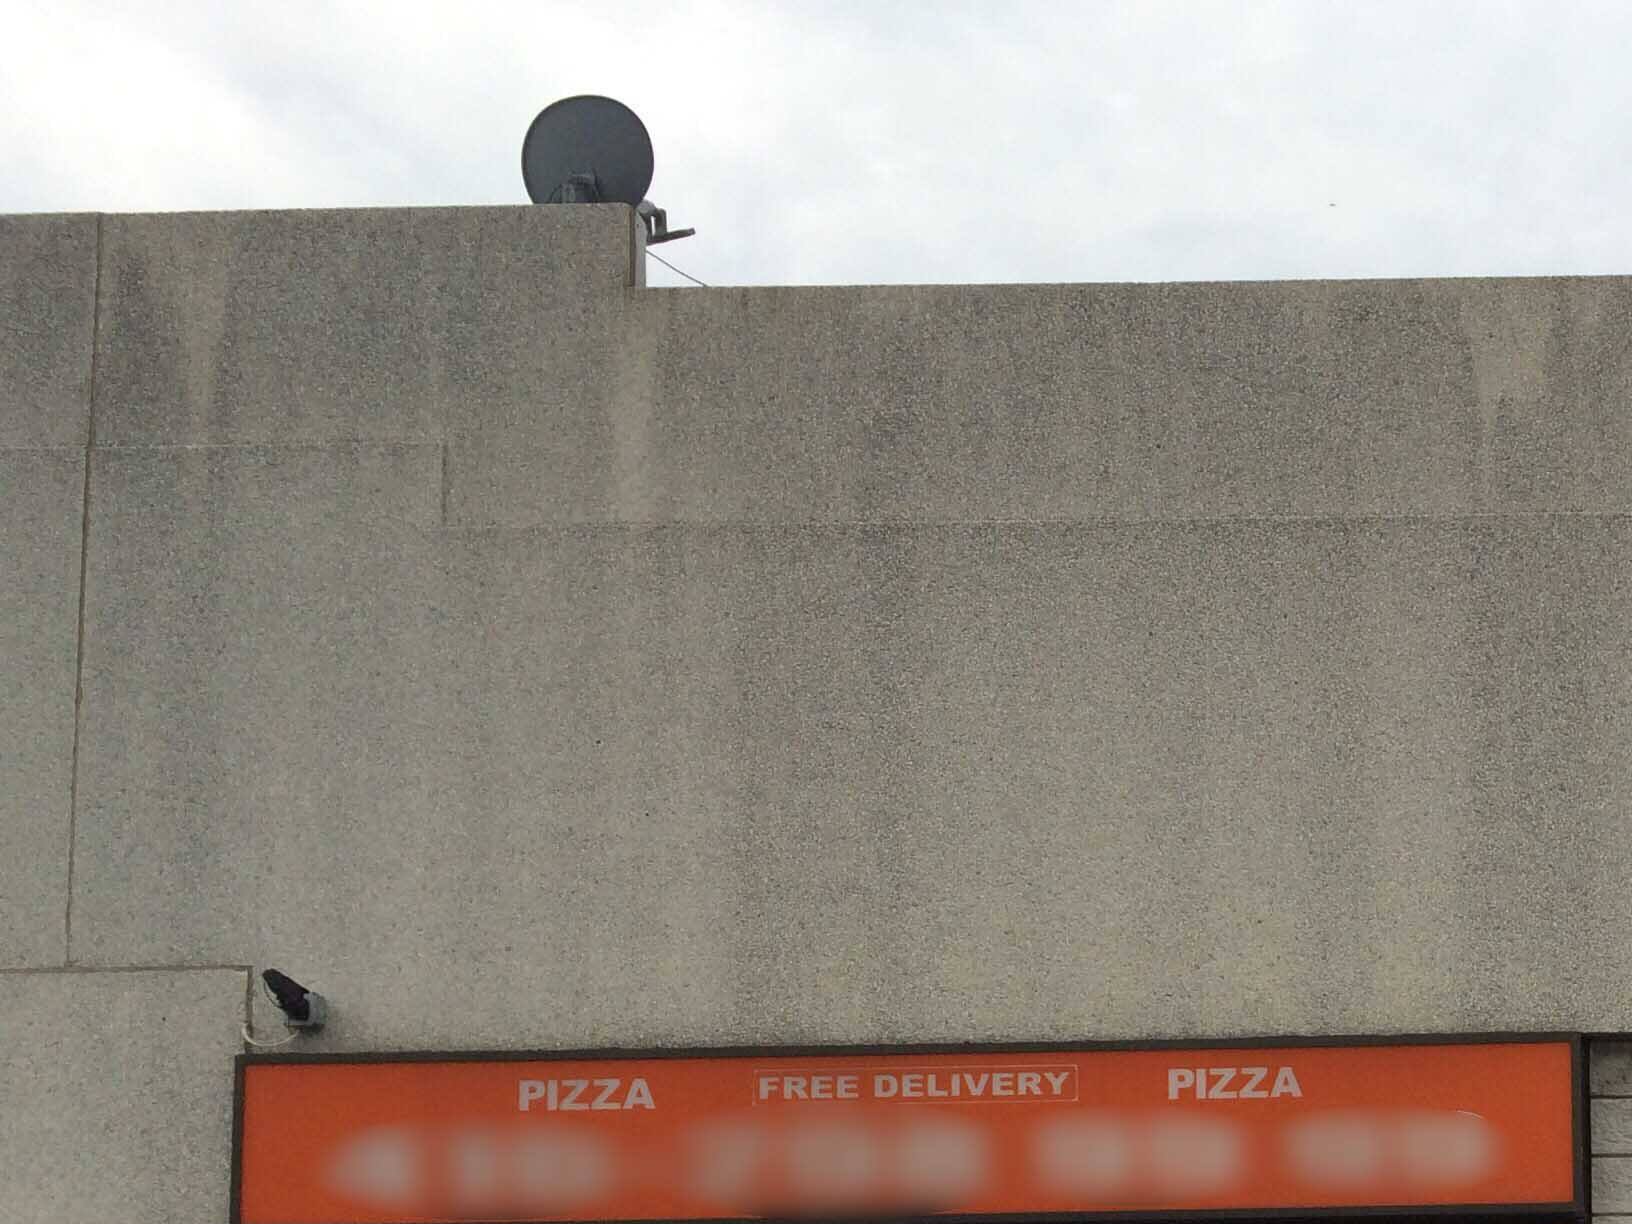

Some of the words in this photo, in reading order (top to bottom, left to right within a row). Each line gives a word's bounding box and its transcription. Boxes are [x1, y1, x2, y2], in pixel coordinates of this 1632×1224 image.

[518, 1077, 656, 1111] PIZZA
[758, 1074, 860, 1100] FREE
[873, 1071, 1070, 1098] DELIVERY
[1168, 1066, 1303, 1100] PIZZA
